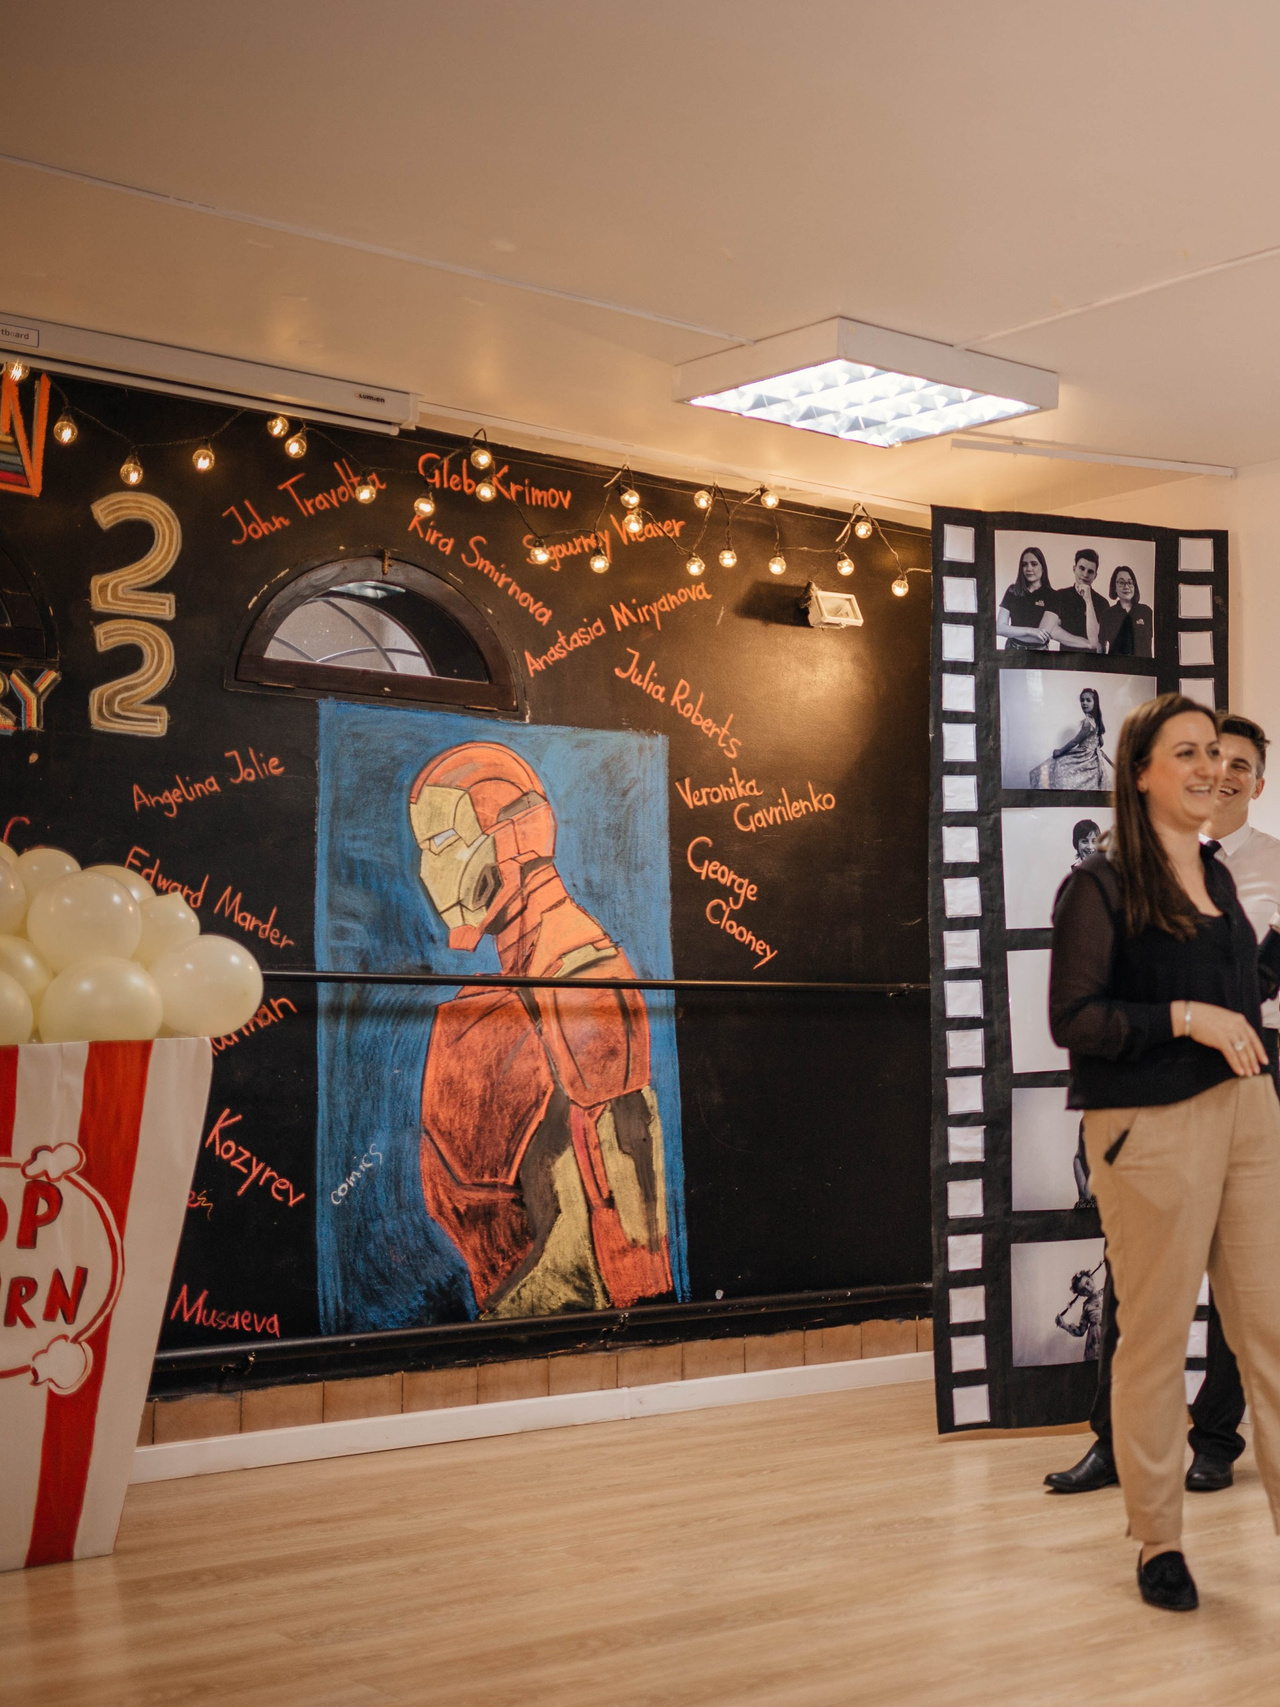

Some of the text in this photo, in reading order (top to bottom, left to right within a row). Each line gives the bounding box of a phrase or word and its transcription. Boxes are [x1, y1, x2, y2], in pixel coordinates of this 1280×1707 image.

[418, 452, 572, 510] Gleb Krimov
[221, 499, 291, 545] John
[408, 514, 552, 626] Kira Smirnova
[524, 582, 713, 678] Anastasia Miryanova
[614, 648, 741, 759] Julia Roberts
[132, 747, 286, 818] Angelina Jolie
[675, 767, 764, 809] Veronika
[733, 782, 836, 833] Gavrilenko
[687, 836, 758, 910] George
[213, 885, 295, 949] Marder
[705, 899, 778, 970] Clooney
[205, 1108, 306, 1207] Kozyrev
[170, 1284, 281, 1338] Musaeva
